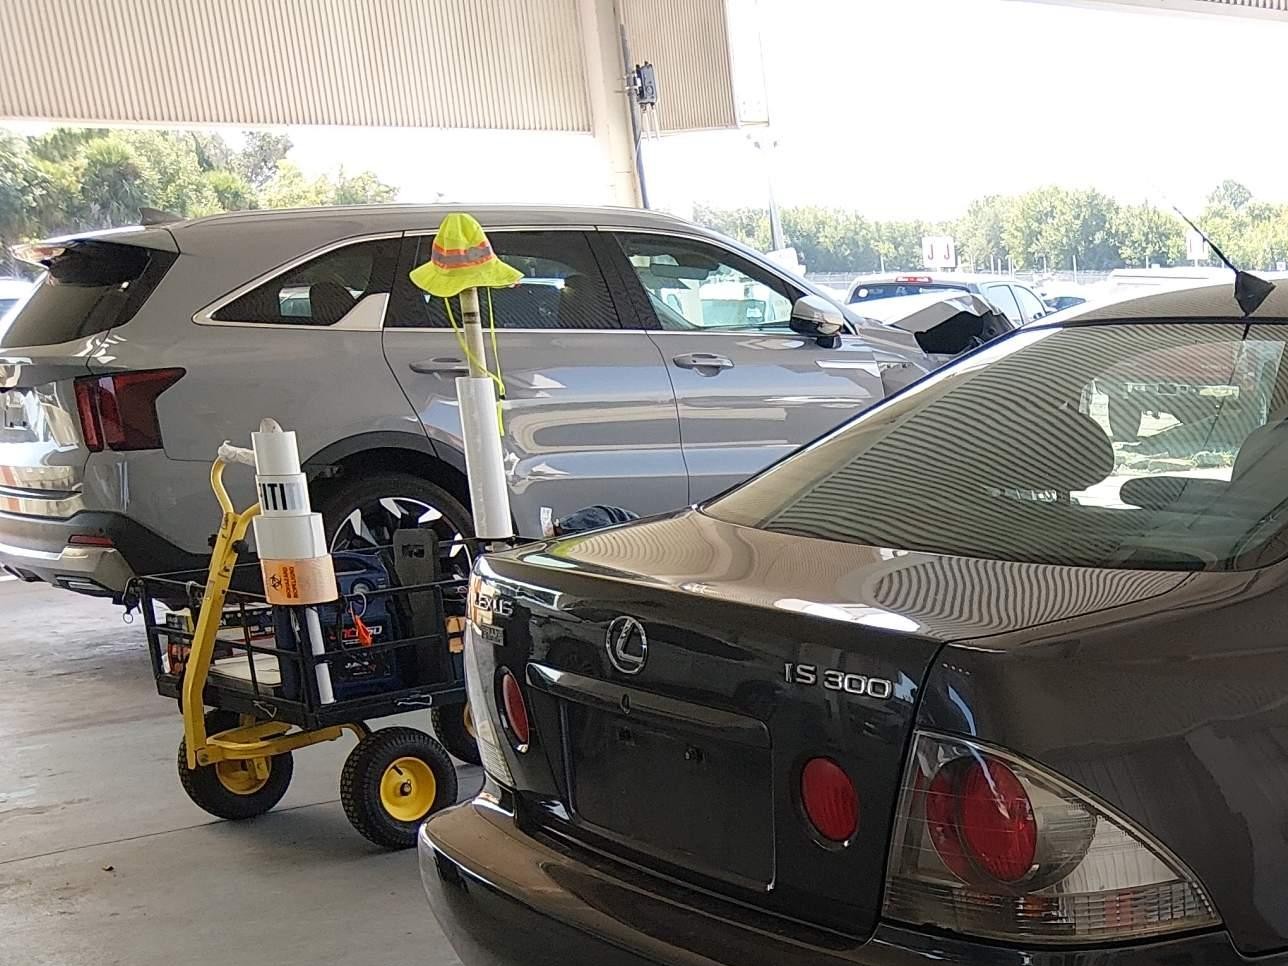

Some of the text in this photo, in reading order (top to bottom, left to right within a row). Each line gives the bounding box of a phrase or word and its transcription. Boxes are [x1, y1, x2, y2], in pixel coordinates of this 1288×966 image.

[475, 592, 514, 616] LEXUS
[784, 663, 892, 699] IS 300
